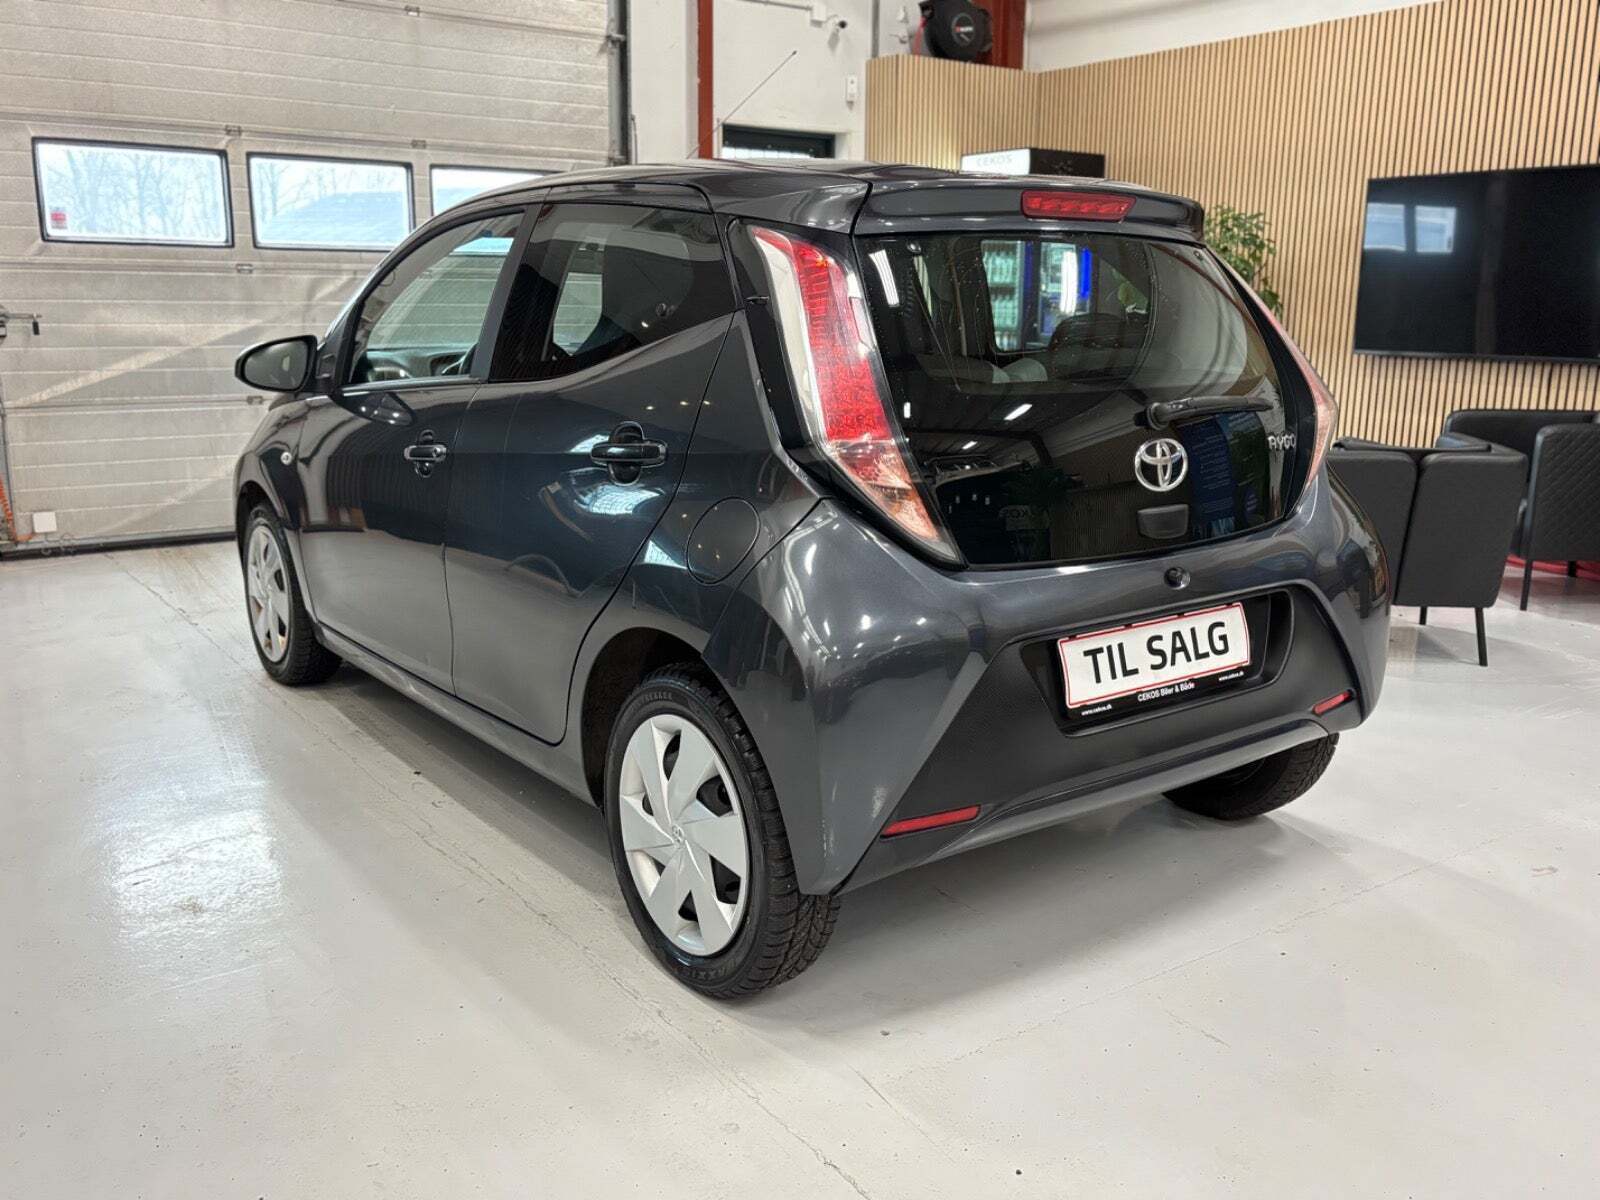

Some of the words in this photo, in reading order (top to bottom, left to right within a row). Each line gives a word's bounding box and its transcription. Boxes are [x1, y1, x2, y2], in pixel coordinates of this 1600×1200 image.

[1267, 433, 1297, 450] AYGO
[1083, 641, 1139, 684] TIL
[1146, 621, 1230, 671] SALG
[1137, 689, 1161, 702] CEKOS
[1160, 687, 1174, 697] Biler
[1174, 684, 1180, 693] &
